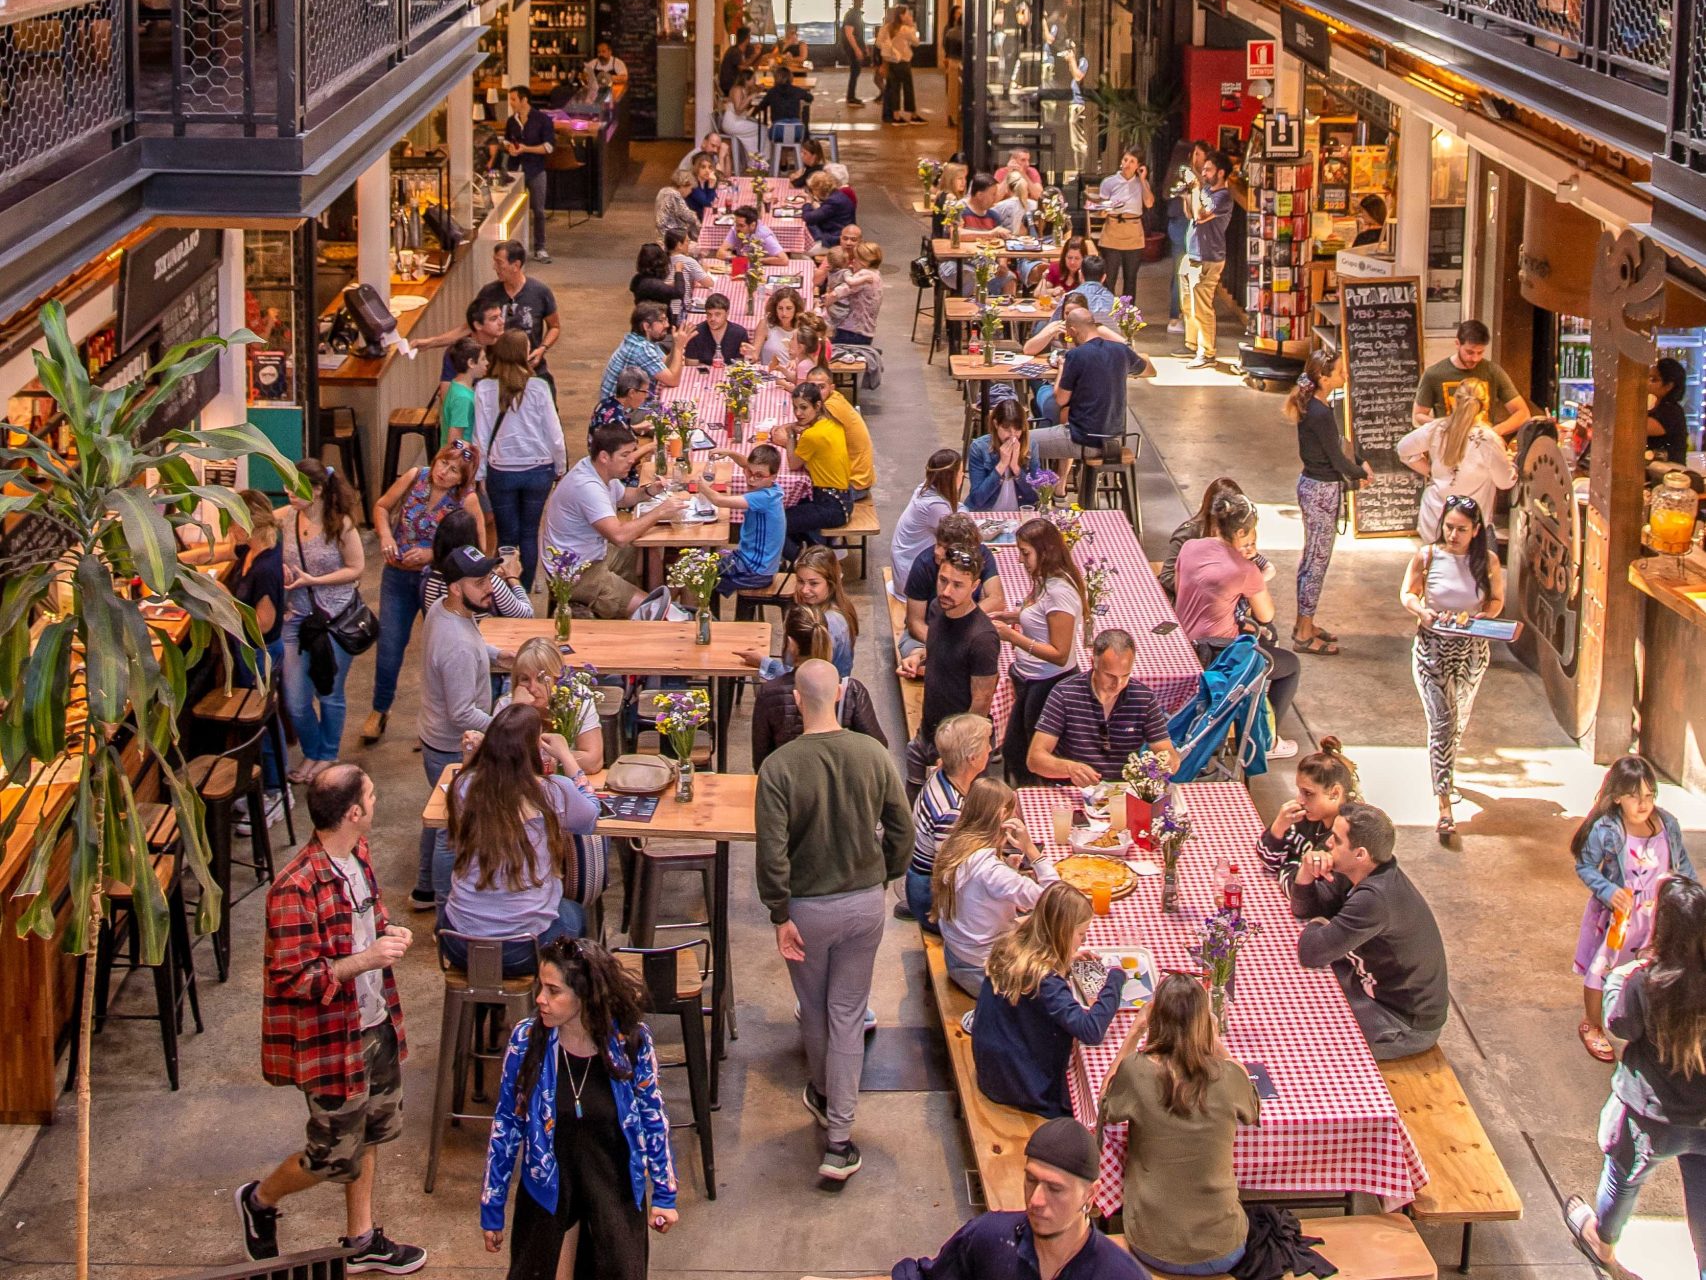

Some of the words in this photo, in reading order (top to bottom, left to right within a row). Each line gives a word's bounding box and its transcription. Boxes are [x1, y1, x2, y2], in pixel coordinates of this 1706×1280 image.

[1324, 201, 1346, 210] 2020
[1341, 257, 1358, 268] Grupo
[1366, 263, 1386, 275] Planeta
